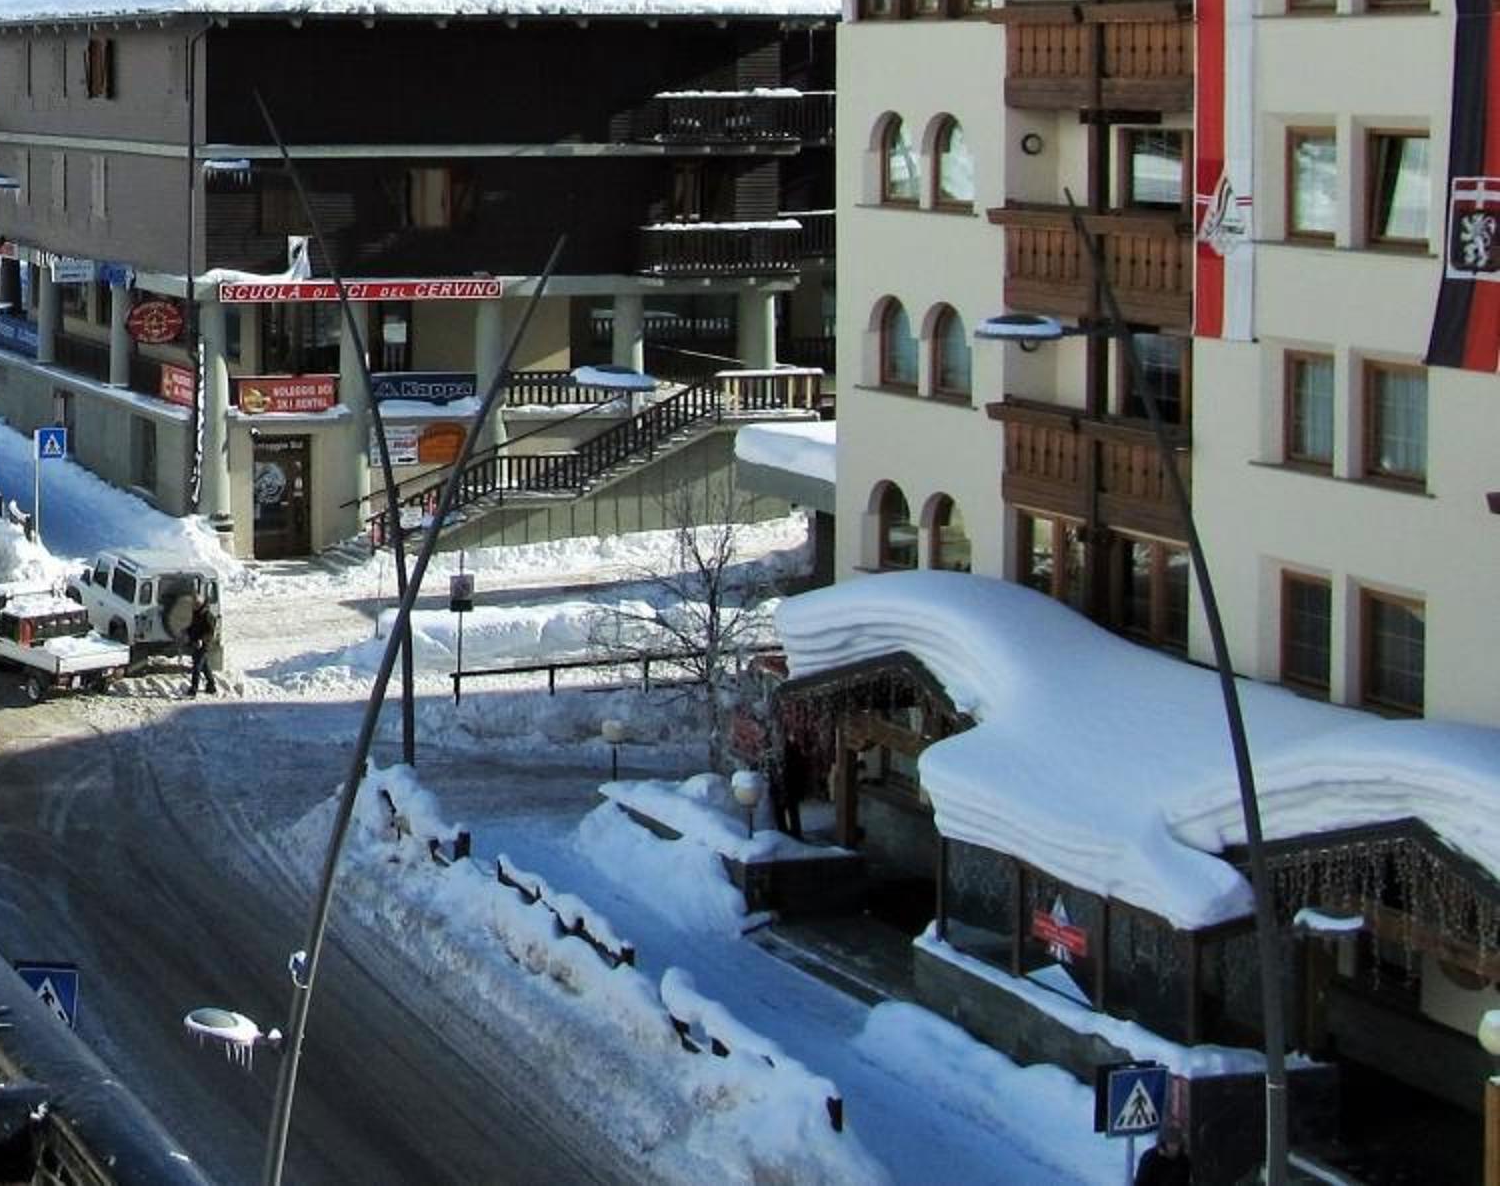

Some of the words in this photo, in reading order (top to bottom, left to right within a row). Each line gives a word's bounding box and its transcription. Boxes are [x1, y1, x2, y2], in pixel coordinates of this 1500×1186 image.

[223, 283, 301, 299] SCUOLA
[380, 285, 406, 297] DEL
[415, 282, 499, 298] CERVINO
[401, 381, 473, 399] Kappa
